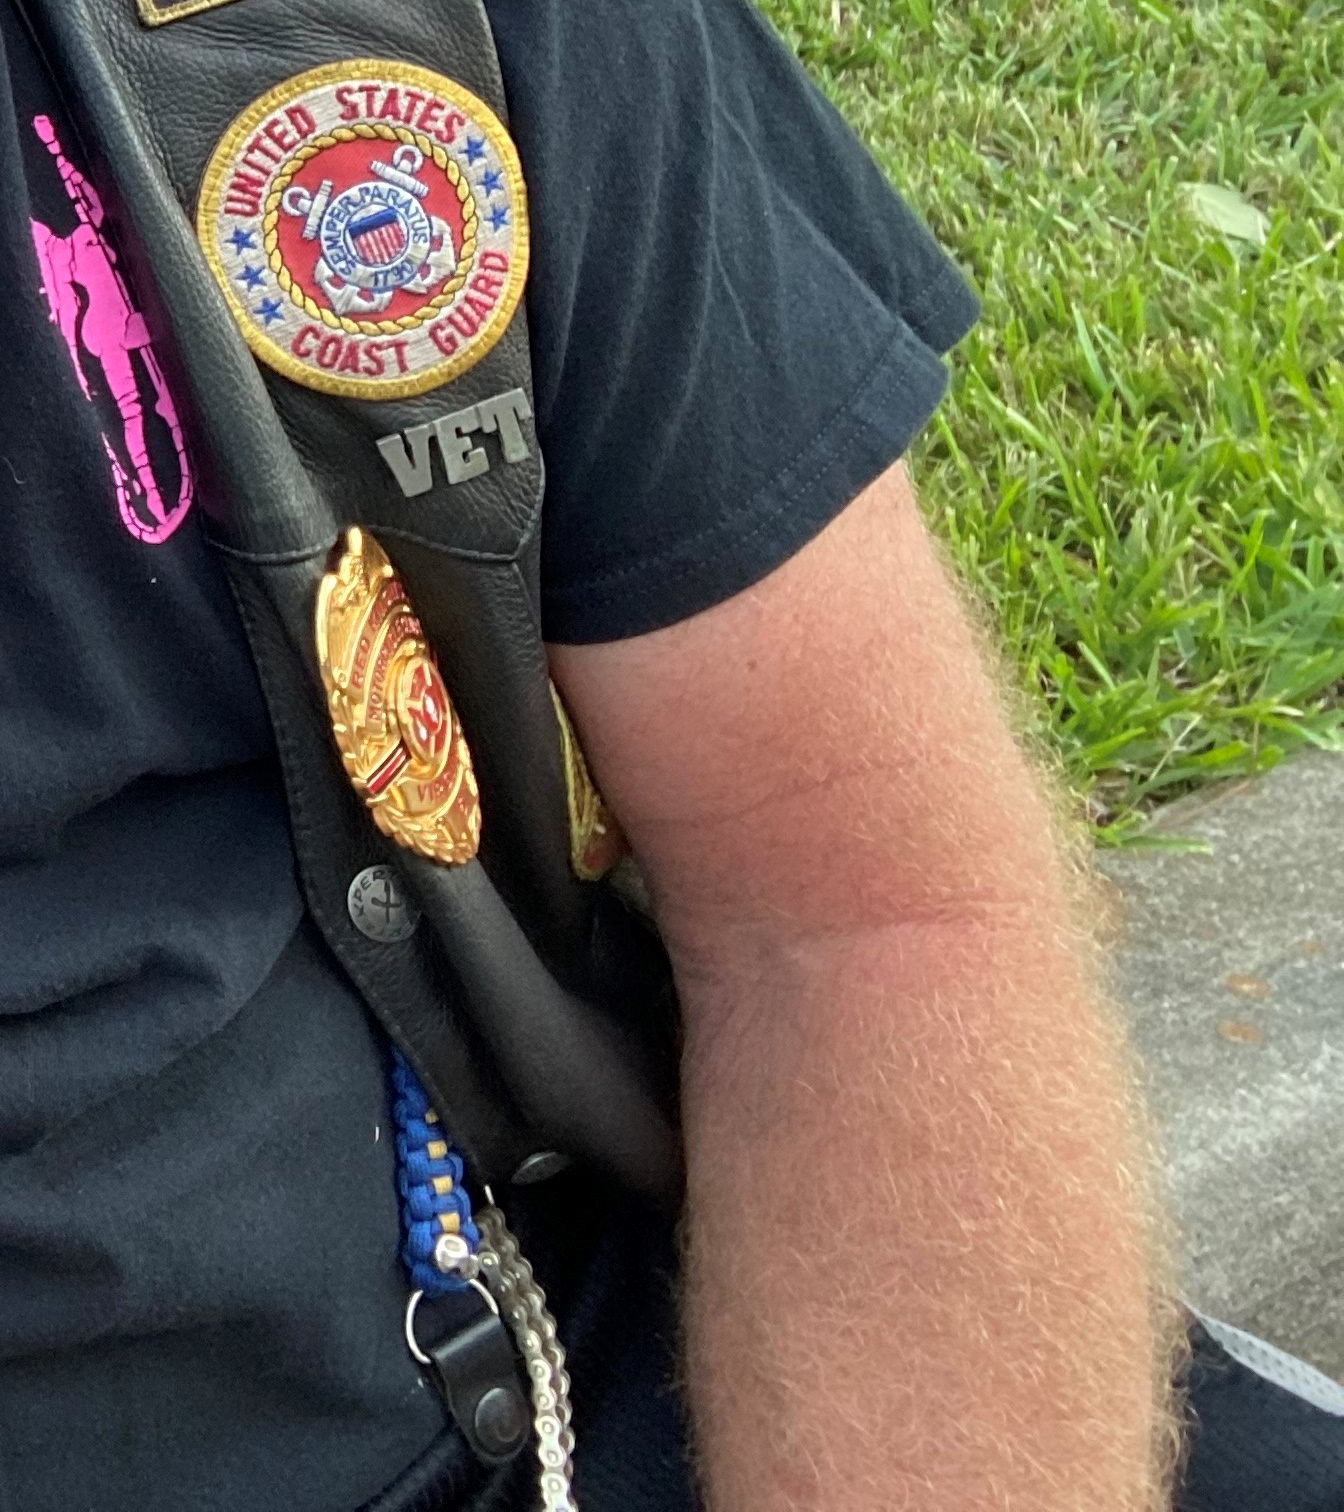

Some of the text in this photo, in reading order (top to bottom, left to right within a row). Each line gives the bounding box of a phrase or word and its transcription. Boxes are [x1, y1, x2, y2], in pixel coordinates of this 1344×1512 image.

[223, 84, 466, 218] UNITED STATES
[324, 185, 428, 276] SEMPER PARATUS
[291, 249, 510, 377] COAST GUARD
[374, 387, 533, 499] VET
